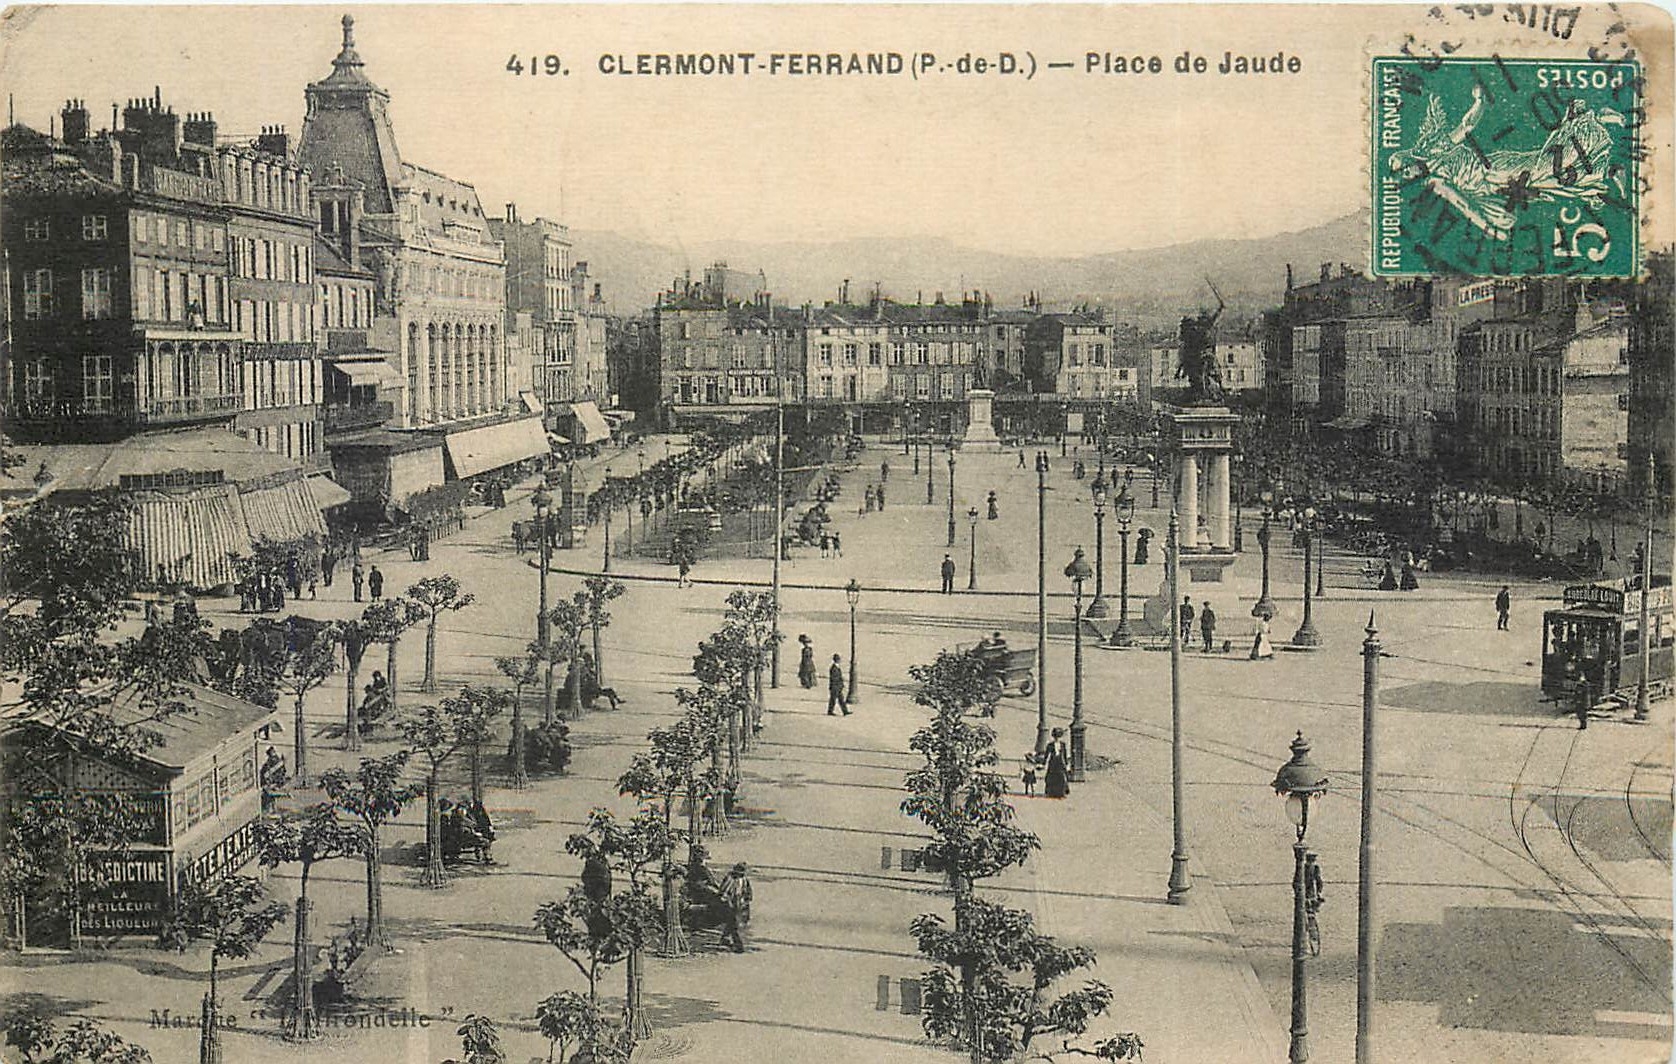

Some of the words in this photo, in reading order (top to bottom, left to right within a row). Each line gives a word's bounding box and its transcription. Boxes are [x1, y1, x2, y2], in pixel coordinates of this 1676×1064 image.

[1536, 68, 1624, 89] POSTES
[112, 891, 128, 899] LA
[104, 915, 159, 929] LIQUEUR
